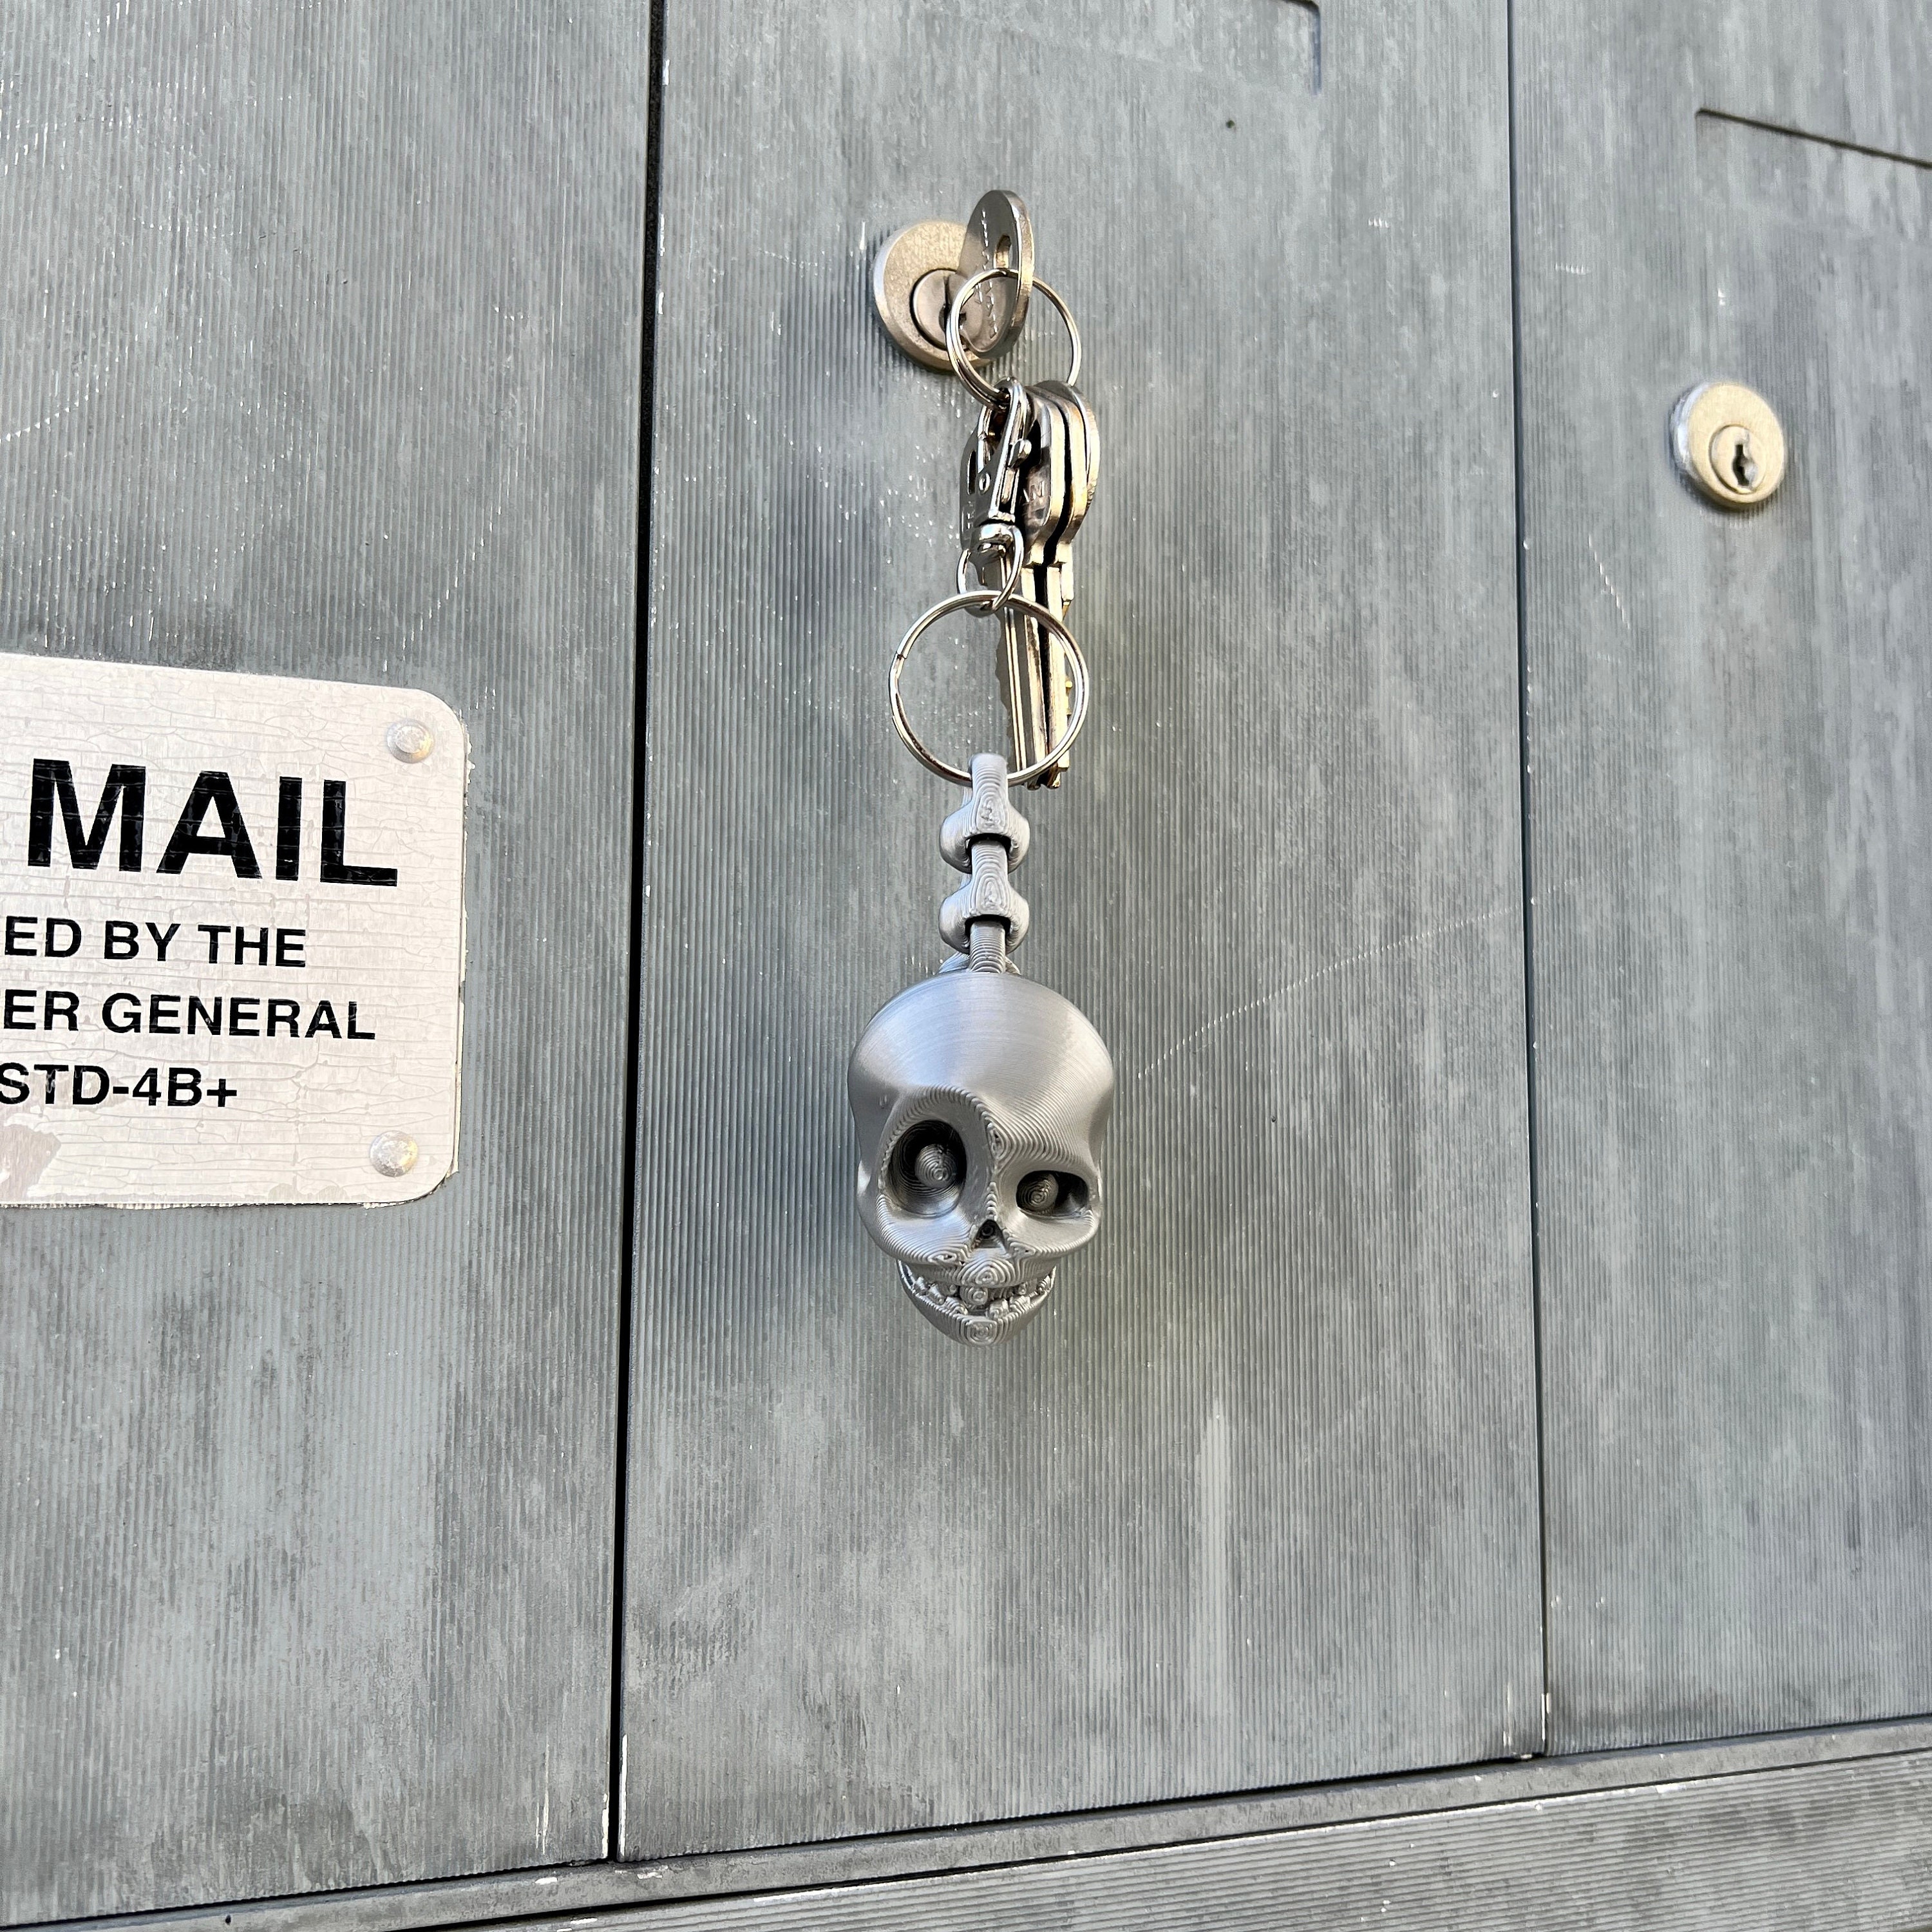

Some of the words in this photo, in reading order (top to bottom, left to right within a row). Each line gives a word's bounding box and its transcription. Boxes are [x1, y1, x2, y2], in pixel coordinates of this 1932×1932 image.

[28, 758, 398, 887] MAIL
[4, 915, 82, 958] ED
[104, 920, 181, 961] BY
[198, 924, 307, 968] THE
[3, 989, 80, 1031] ER
[102, 992, 376, 1040] GENERAL
[0, 1062, 238, 1108] STD-4B+
